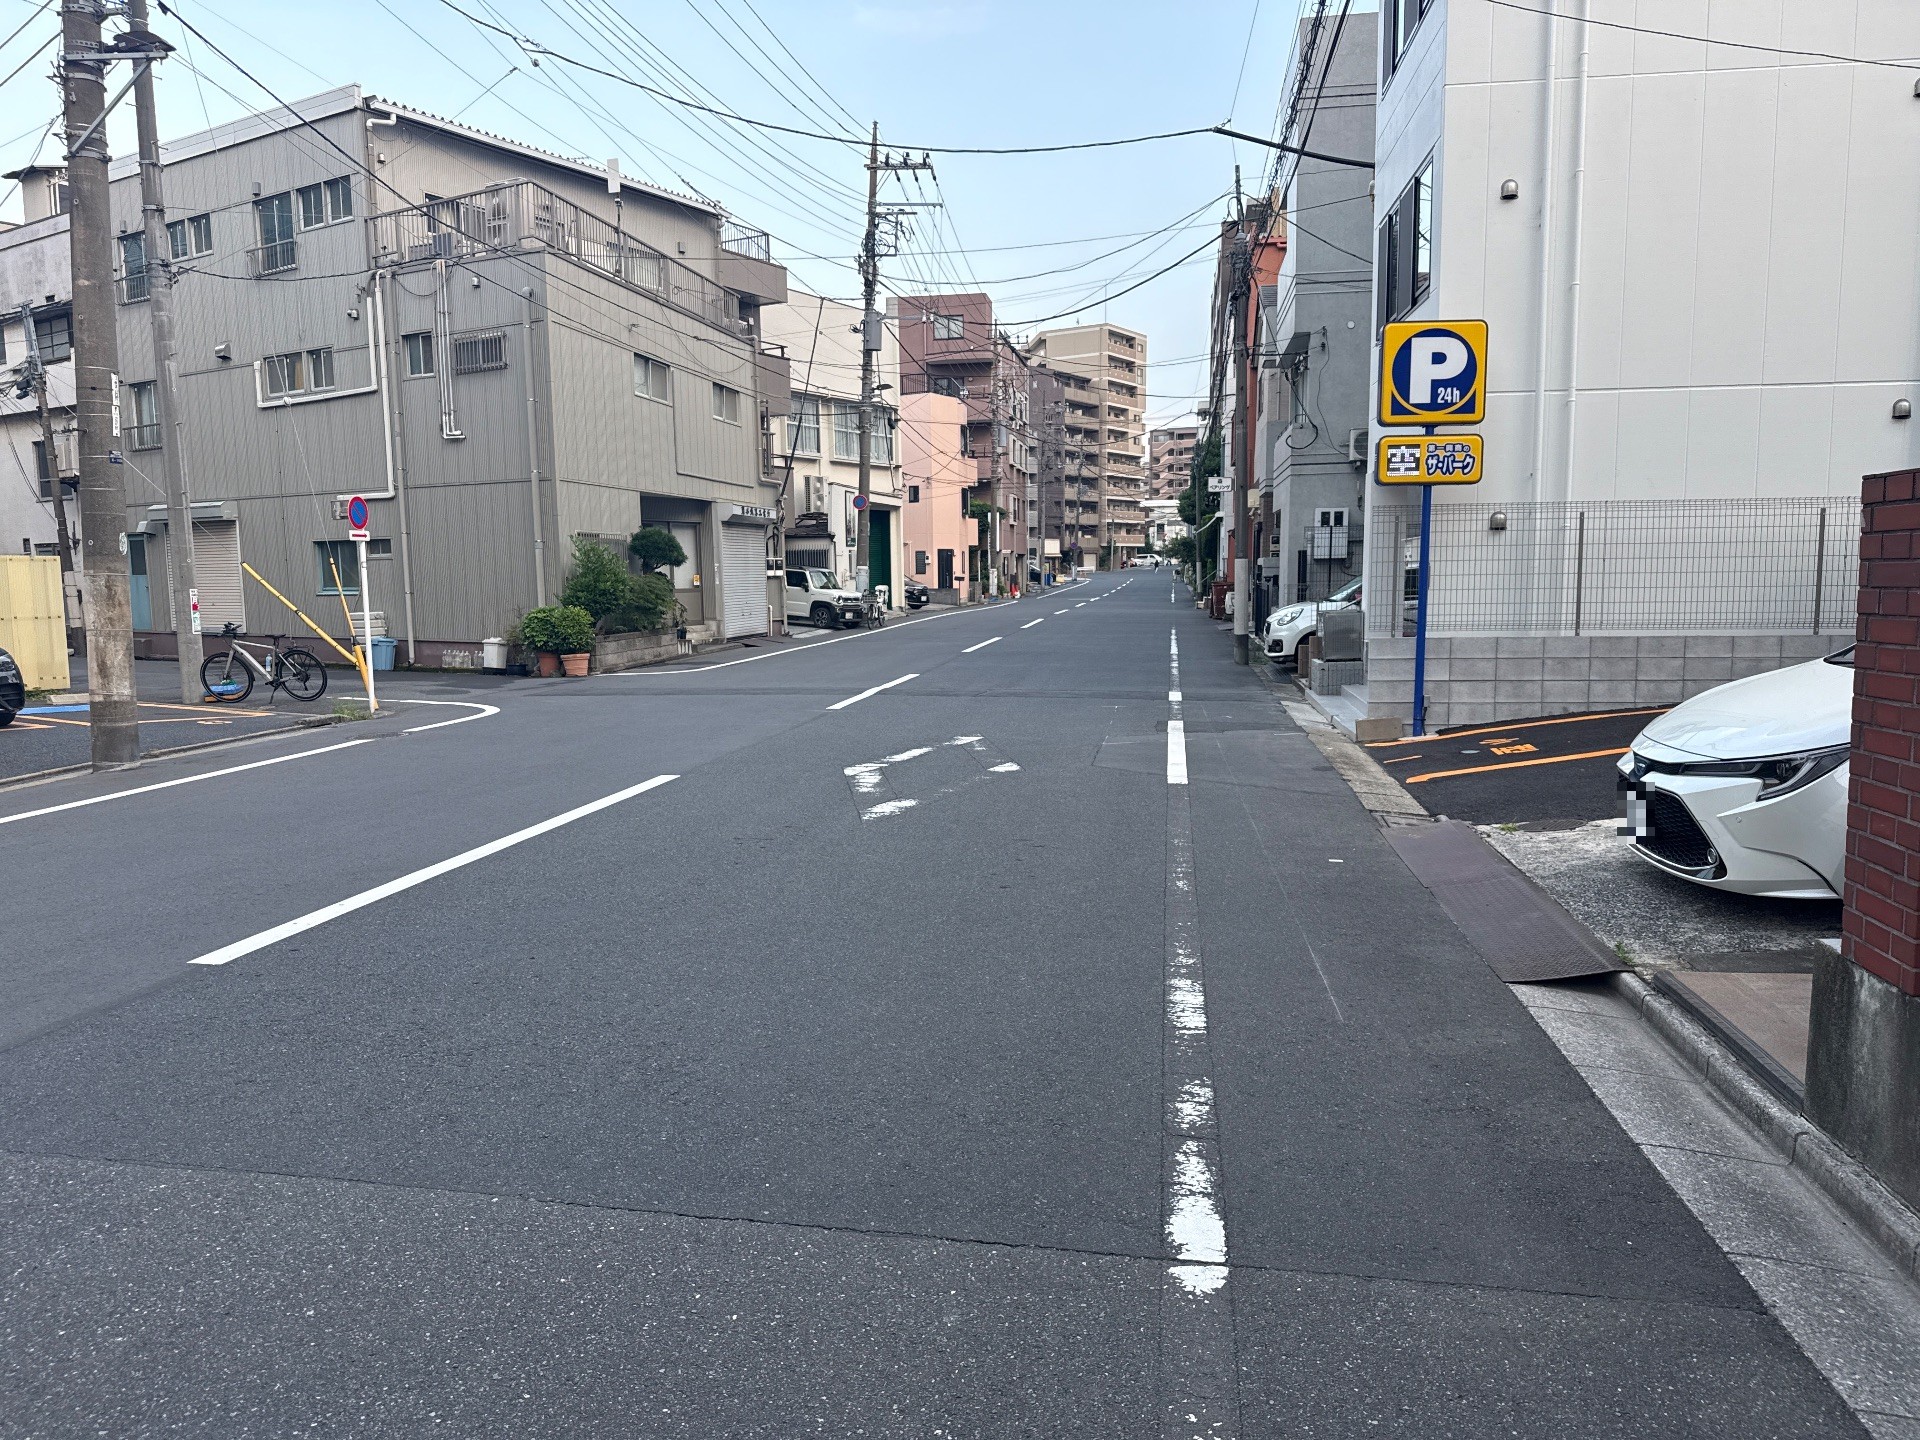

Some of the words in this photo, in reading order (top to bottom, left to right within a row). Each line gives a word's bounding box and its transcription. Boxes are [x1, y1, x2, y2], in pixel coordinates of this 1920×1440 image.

[1409, 336, 1469, 404] P
[1437, 387, 1461, 404] 24h
[1387, 446, 1420, 477] 空
